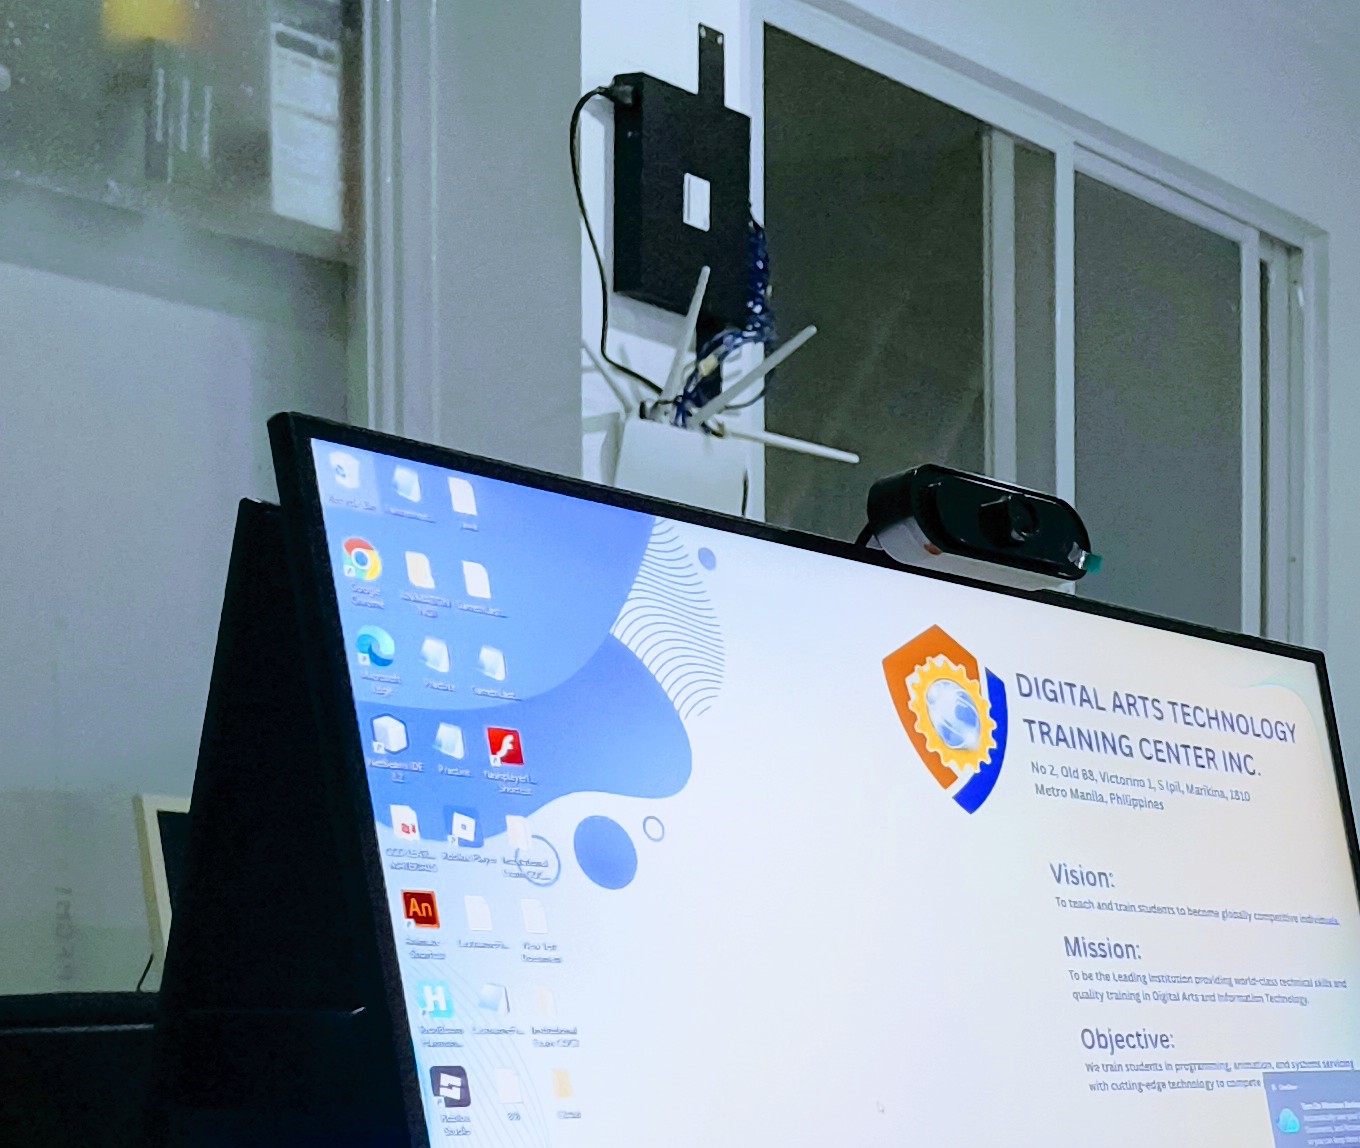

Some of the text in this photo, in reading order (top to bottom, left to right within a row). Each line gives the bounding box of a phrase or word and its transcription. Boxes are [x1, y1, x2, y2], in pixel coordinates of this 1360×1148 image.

[1015, 672, 1298, 743] DIGITAL ARTS TECHNOLOGY
[1023, 718, 1262, 777] TRAINING CENTER INC.
[1030, 761, 1047, 775] No
[1061, 767, 1079, 780] Old
[1034, 783, 1165, 811] Metro Manila, Philippines
[1050, 863, 1115, 888] Vision:
[409, 898, 433, 917] An
[1056, 897, 1067, 908] To
[1064, 935, 1141, 960] Mission:
[1068, 969, 1080, 981] To
[1081, 971, 1093, 981] be
[1095, 971, 1110, 981] the
[1072, 989, 1103, 1002] quality
[1080, 1028, 1175, 1055] Objective:
